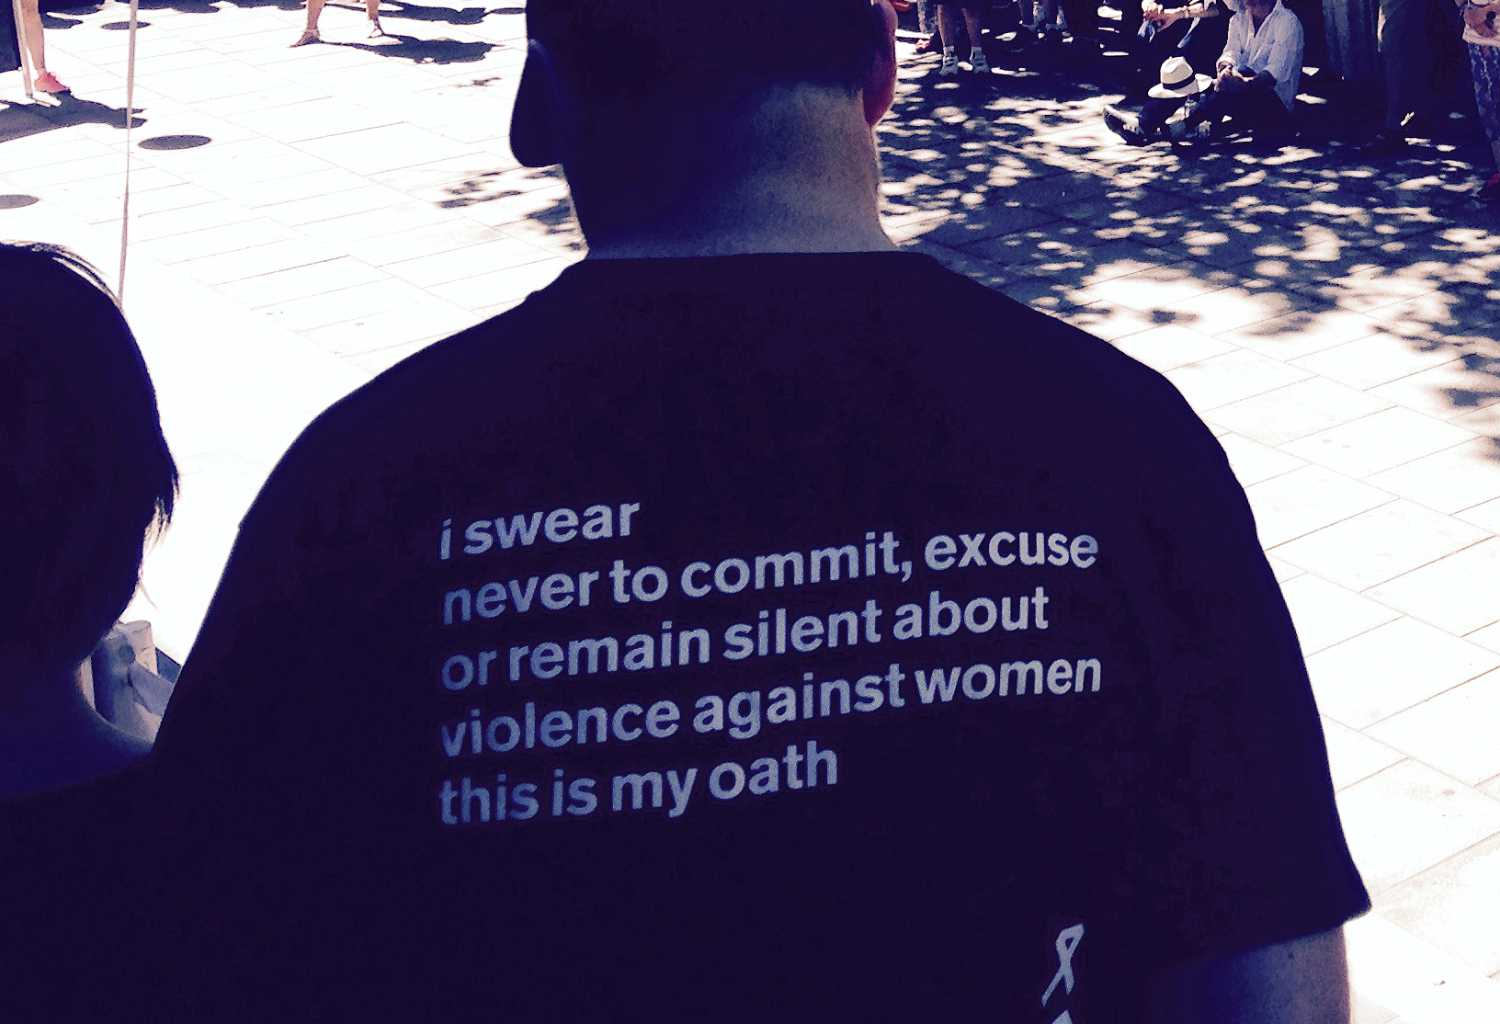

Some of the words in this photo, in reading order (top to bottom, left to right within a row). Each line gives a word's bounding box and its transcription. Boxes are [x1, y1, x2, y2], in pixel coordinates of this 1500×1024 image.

[440, 518, 452, 560] i
[463, 502, 640, 555] swear
[443, 571, 600, 624] never
[609, 559, 668, 603] to
[680, 531, 912, 598] commit,
[924, 531, 1098, 571] excuse
[441, 644, 497, 691] or
[508, 620, 710, 682] remain
[723, 599, 882, 660] silent
[893, 586, 1049, 641] about
[441, 702, 681, 757] violence
[692, 663, 906, 739] against
[914, 657, 1102, 704] women
[439, 774, 540, 825] this
[551, 769, 598, 817] is
[611, 768, 698, 818] my
[709, 740, 838, 801] oath
